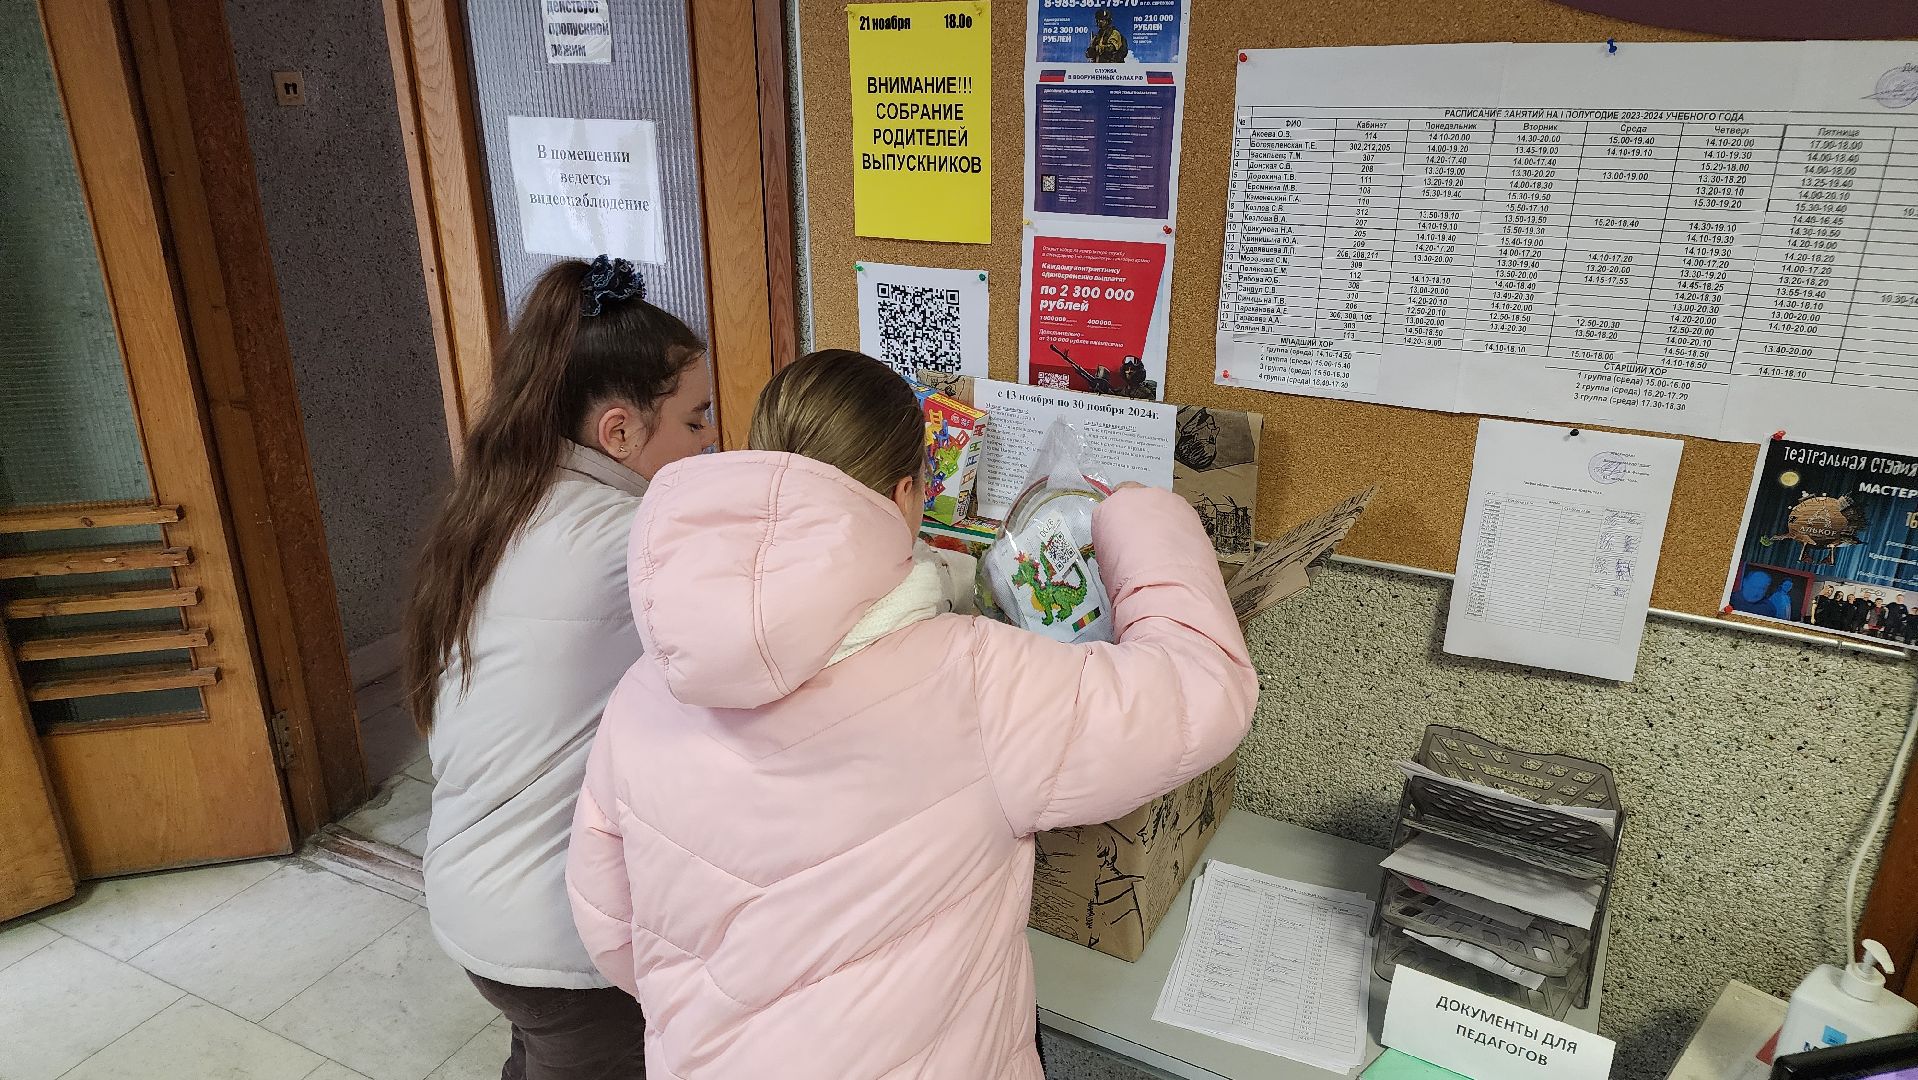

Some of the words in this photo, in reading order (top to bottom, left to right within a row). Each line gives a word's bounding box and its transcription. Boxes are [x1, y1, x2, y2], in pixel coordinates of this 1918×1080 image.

[548, 19, 609, 36] пропускной
[859, 16, 870, 30] 21
[872, 15, 911, 31] ноября
[867, 76, 972, 95] ВНИМАНИЕ!!!
[876, 102, 964, 121] СОБРАНИЕ
[1445, 109, 1502, 119] РАСПИСАНИЕ
[1504, 109, 1544, 119] ЗАНЯТИЙ
[1546, 110, 1558, 119] НА
[1565, 110, 1619, 121] ПОЛУГОДИЕ
[1621, 111, 1664, 121] 2023-2024
[1665, 112, 1717, 122] УЧЕБНОГО
[1718, 112, 1745, 123] ГОДА
[1285, 119, 1302, 128] ФИО
[1356, 120, 1387, 129] Кабинет
[1523, 123, 1558, 133] Вторник
[1620, 124, 1647, 134] Среда
[873, 125, 968, 147] РОДИТЕЛЕЙ
[1608, 136, 1655, 145] 15.00-19.40
[1349, 143, 1391, 151] 302,212,205
[1705, 138, 1755, 147] 14.10-20.00
[537, 144, 547, 159] В
[551, 148, 630, 163] помещении
[1427, 144, 1469, 153] 14.00-19.20
[1606, 148, 1653, 157] 14.10-19.10
[1703, 151, 1752, 160] 14.10-19.30
[862, 153, 982, 174] ВЫПУСКНИКОВ
[560, 172, 611, 186] ведется
[1603, 172, 1649, 180] 13.00-19.00
[1696, 187, 1744, 196] 13.20-19.10
[529, 192, 650, 212] видеонаблюдение
[1694, 199, 1742, 209] 15.30-19.20
[1687, 234, 1735, 244] 14.10-19.30
[1685, 246, 1732, 257] 14.10-19.30
[1497, 260, 1540, 269] 13.30-19.40
[1683, 258, 1730, 269] 14.00-17.20
[1496, 270, 1538, 279] 13.50-20.00
[1040, 285, 1057, 295] по
[1060, 284, 1069, 297] 2
[1072, 285, 1101, 298] 300
[1105, 287, 1135, 301] 000
[1675, 292, 1722, 303] 14.20-18.30
[1040, 298, 1089, 312] рублей
[1673, 304, 1720, 314] 13.00-20.30
[1407, 307, 1446, 317] 12.50-20.10
[1771, 311, 1821, 322] 13.00-20.00
[1405, 317, 1445, 327] 13.00-20.00
[1576, 318, 1620, 329] 12.50-20.30
[1670, 315, 1717, 325] 14.20-20.00
[1574, 329, 1618, 339] 13.50-18.20
[1668, 326, 1714, 336] 12.50-20.00
[1280, 337, 1317, 347] МЛАДШИЙ
[1318, 339, 1334, 348] ХОР
[1666, 336, 1712, 347] 14.00-20.10
[1603, 363, 1648, 374] СТАРШИЙ
[1648, 367, 1668, 376] ХОР
[1584, 373, 1612, 382] группа
[1582, 384, 1610, 392] группа
[1005, 389, 1017, 400] 13
[1018, 393, 1054, 406] ноября
[1057, 399, 1071, 408] по
[1072, 399, 1085, 410] 30
[1086, 402, 1126, 416] ноября
[1127, 405, 1160, 420] 2024г.
[1580, 393, 1608, 402] группа
[1641, 399, 1686, 411] 17.30-18.30
[1435, 994, 1539, 1039] ДОКУМЕНТЫ
[1540, 1031, 1578, 1054] ДЛЯ
[1455, 1023, 1548, 1067] ПЕДАГОГОВ
